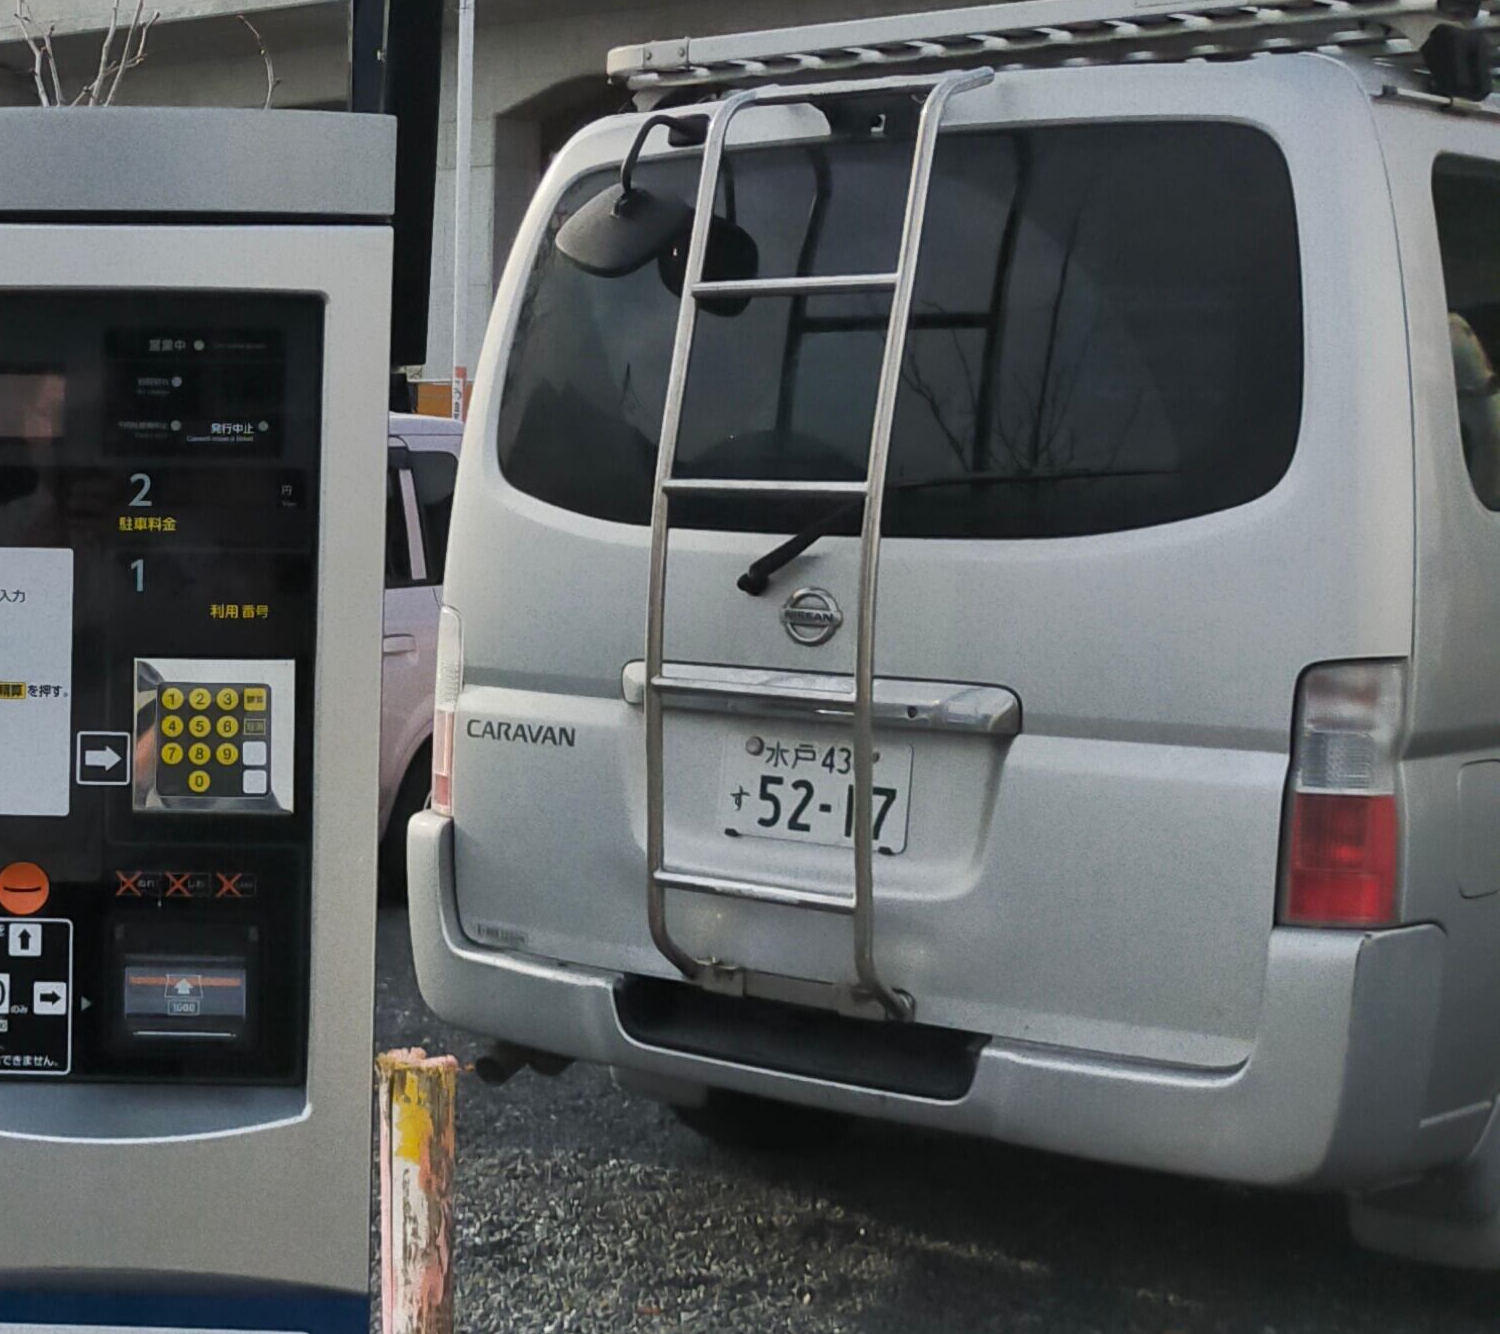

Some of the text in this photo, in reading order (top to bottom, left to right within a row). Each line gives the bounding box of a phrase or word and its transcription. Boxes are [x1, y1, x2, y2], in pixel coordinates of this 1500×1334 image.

[211, 422, 255, 434] 発行中止
[128, 473, 153, 507] 2
[119, 517, 177, 532] 駐車料金
[130, 559, 145, 592] 1
[210, 604, 269, 619] 利用番号
[168, 693, 176, 705] 1
[196, 693, 205, 705] 2
[223, 693, 232, 705] 3
[168, 721, 232, 733] 4 5 6
[466, 718, 576, 748] CARAVAN
[168, 748, 232, 760] 7 8 9
[195, 776, 204, 787] 0
[730, 785, 750, 811] す
